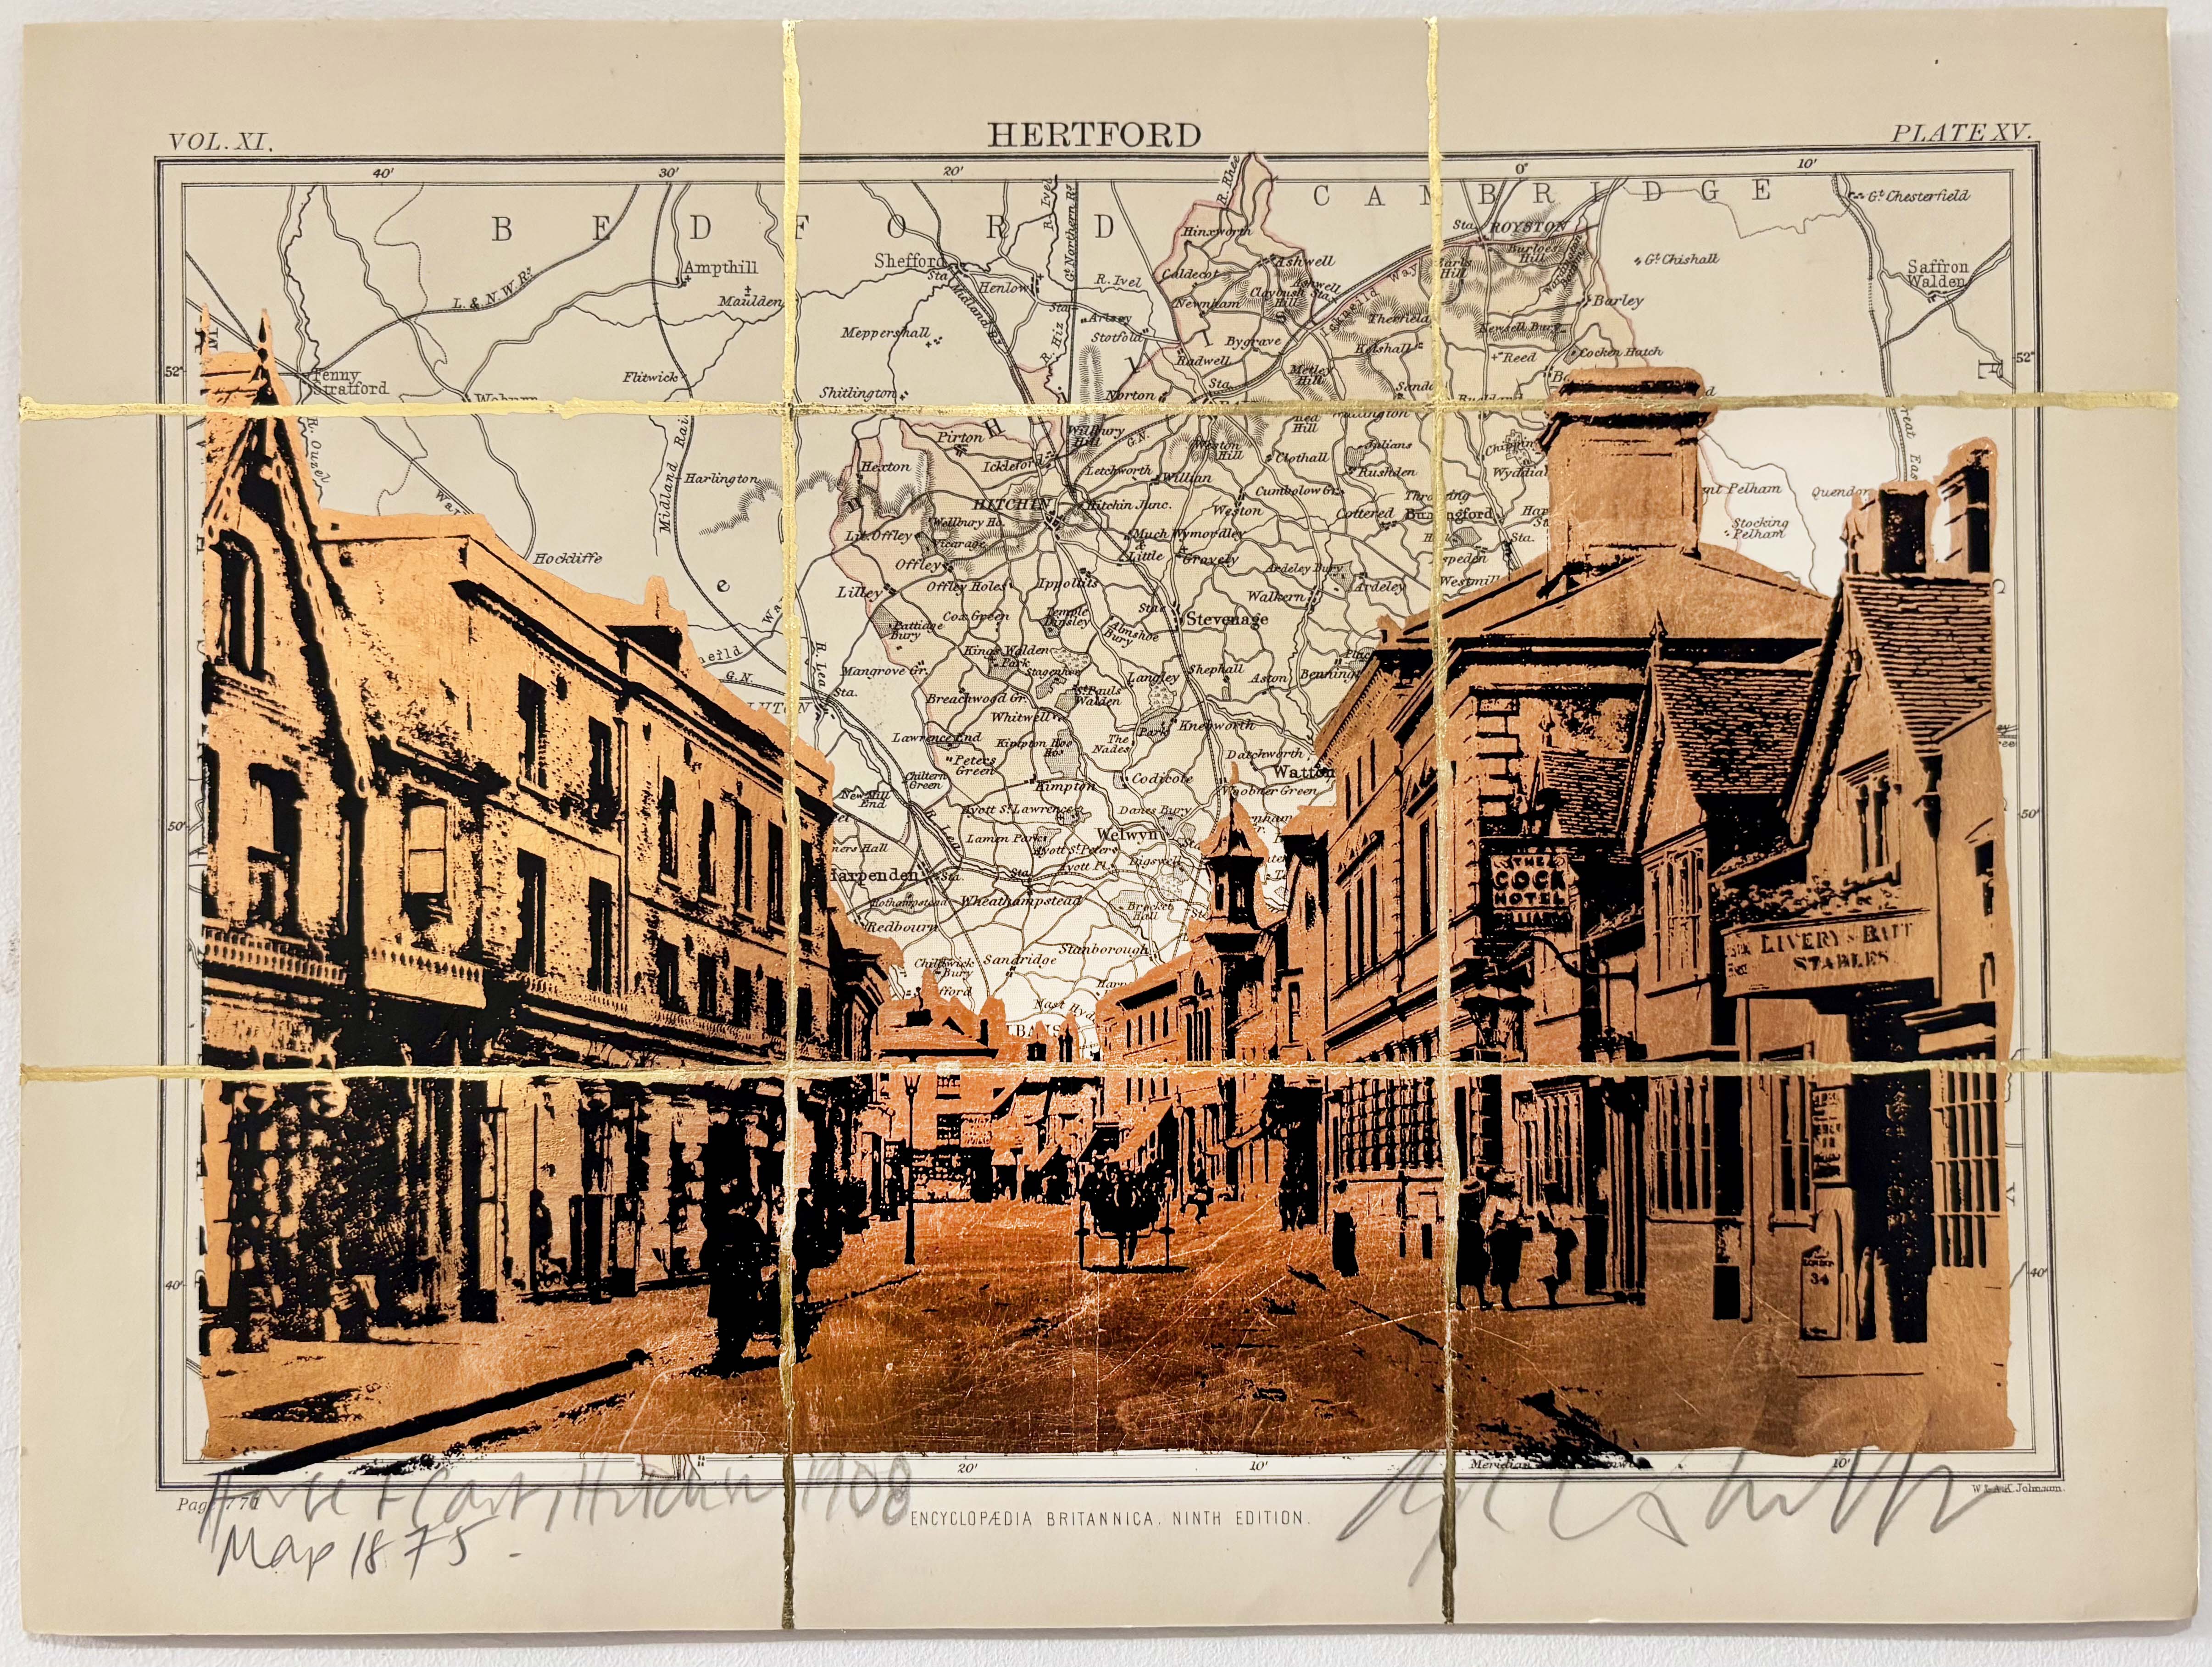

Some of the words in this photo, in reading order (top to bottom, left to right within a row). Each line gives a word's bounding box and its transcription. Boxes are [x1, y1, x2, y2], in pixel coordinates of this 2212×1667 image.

[987, 122, 1201, 148] HERTFORD
[1890, 124, 1985, 142] PLATE
[1991, 123, 2031, 141] XV.
[169, 133, 230, 150] VOL.
[234, 133, 272, 152] XI.
[1221, 155, 1240, 187] Rhee
[1041, 179, 1052, 207] Ivel
[1887, 189, 1969, 201] Chesterfield
[1181, 226, 1252, 237] Hinxworth
[1490, 221, 1567, 233] ROYSTON
[1065, 205, 1074, 266] Northern
[875, 254, 945, 268] Shefford
[1273, 255, 1334, 267] Ashwell
[1663, 254, 1719, 264] Chishall
[684, 261, 758, 277] Ampthill
[1908, 260, 1968, 273] Saffron
[1162, 269, 1217, 278] Caldecot
[1387, 261, 1419, 284] Way
[1113, 276, 1141, 288] Ivel
[1908, 275, 1965, 288] Walden
[978, 282, 1031, 293] Henlow
[1250, 287, 1305, 298] Claybush
[719, 296, 784, 307] Maulden
[950, 283, 990, 329] Midland
[1172, 298, 1240, 308] Newnham
[1274, 298, 1297, 308] Hill
[1592, 295, 1644, 309] Barley
[841, 327, 931, 339] Meppershall
[1091, 332, 1143, 342] Stotfold
[1225, 336, 1280, 348] Bygrave
[1355, 344, 1411, 354] Kelshall
[1626, 347, 1664, 356] Hatch
[1175, 356, 1230, 366] Radwell
[1502, 353, 1536, 362] Reed
[623, 372, 678, 383] Flitwick
[1296, 376, 1324, 386] Hill
[313, 382, 389, 395] Stratford
[820, 387, 895, 401] Shitlington
[1105, 391, 1156, 400] Norton
[1068, 426, 1125, 436] Wilbury
[1292, 423, 1317, 433] Hill
[938, 433, 984, 443] Pirton
[1365, 440, 1412, 450] Julians
[1218, 450, 1244, 460] Hill
[1276, 453, 1328, 462] Clothall
[310, 440, 330, 483] Ouzel
[861, 462, 911, 472] Hexton
[984, 455, 1045, 472] Ickleford
[1085, 467, 1151, 475] Letchworth
[1358, 467, 1417, 477] Rushden
[684, 473, 757, 487] Harlington
[1727, 483, 1781, 494] Pelham
[660, 461, 677, 534] Midland
[972, 499, 1052, 511] HITCHIN
[1087, 500, 1132, 509] Hitchin
[1214, 505, 1263, 517] Weston
[1336, 509, 1394, 518] Cottered
[1732, 517, 1788, 531] Stocking
[873, 531, 912, 543] Offley
[1134, 529, 1168, 539] Much
[1733, 529, 1786, 539] Pelham
[534, 553, 602, 565] Hockliffe
[1127, 551, 1163, 561] Little
[1183, 555, 1239, 567] Gravely
[895, 559, 940, 571] Offley
[1312, 564, 1343, 574] Bury
[836, 586, 882, 599] Lilley
[927, 582, 964, 595] Offley
[971, 582, 1007, 591] Holes
[1352, 583, 1405, 594] Ardeley
[1247, 590, 1306, 602] Walkern
[943, 612, 968, 622] Cox
[972, 612, 1009, 621] Green
[1047, 606, 1088, 618] Temple
[1187, 611, 1267, 625] Stevenage
[889, 631, 920, 641] Bury
[1109, 622, 1159, 642] Almshoe
[1104, 630, 1132, 647] Bury
[964, 646, 997, 655] Kings
[1004, 646, 1047, 655] Walden
[1002, 658, 1029, 667] Park
[840, 667, 905, 680] Mangrove
[1189, 664, 1244, 674] Shephall
[817, 663, 827, 688] Lea
[1128, 672, 1179, 684] Langley
[1249, 674, 1287, 683] Aston
[1089, 686, 1121, 695] Pauls
[928, 693, 1006, 704] Breachwood
[1078, 696, 1122, 706] Walden
[992, 712, 1049, 722] Whitwell
[1180, 721, 1255, 731] Knebworth
[894, 733, 950, 742] Lawrence
[954, 733, 981, 742] End
[1109, 735, 1128, 743] The
[997, 739, 1047, 749] Kimpton
[1092, 745, 1129, 753] Nades
[1226, 750, 1303, 759] Datchworth
[953, 756, 995, 765] Peters
[956, 766, 994, 775] Green
[905, 772, 947, 781] Chiltern
[1133, 773, 1193, 784] Codicote
[910, 781, 942, 790] Green
[1036, 782, 1095, 793] Kimpton
[1281, 786, 1316, 795] Green
[859, 800, 886, 808] End
[1161, 806, 1191, 817] Bury
[1097, 828, 1157, 842] Welwyn
[861, 844, 889, 853] Hall
[1129, 856, 1181, 866] Digswell
[961, 895, 1082, 908] Wheathampstead
[1128, 903, 1170, 912] Brocket
[1133, 911, 1157, 920] Hall
[867, 921, 939, 933] Redbourn
[1059, 945, 1148, 955] Stanborough
[984, 955, 1057, 968] Sandridge
[944, 968, 973, 978] Bury
[804, 1451, 911, 1526] 1908
[223, 1496, 260, 1511] 771
[911, 1511, 1033, 1527] ENCYCLOPÆDIA
[1174, 1510, 1221, 1526] NINTH
[1237, 1510, 1311, 1526] EDITION.
[218, 1523, 336, 1582] Map
